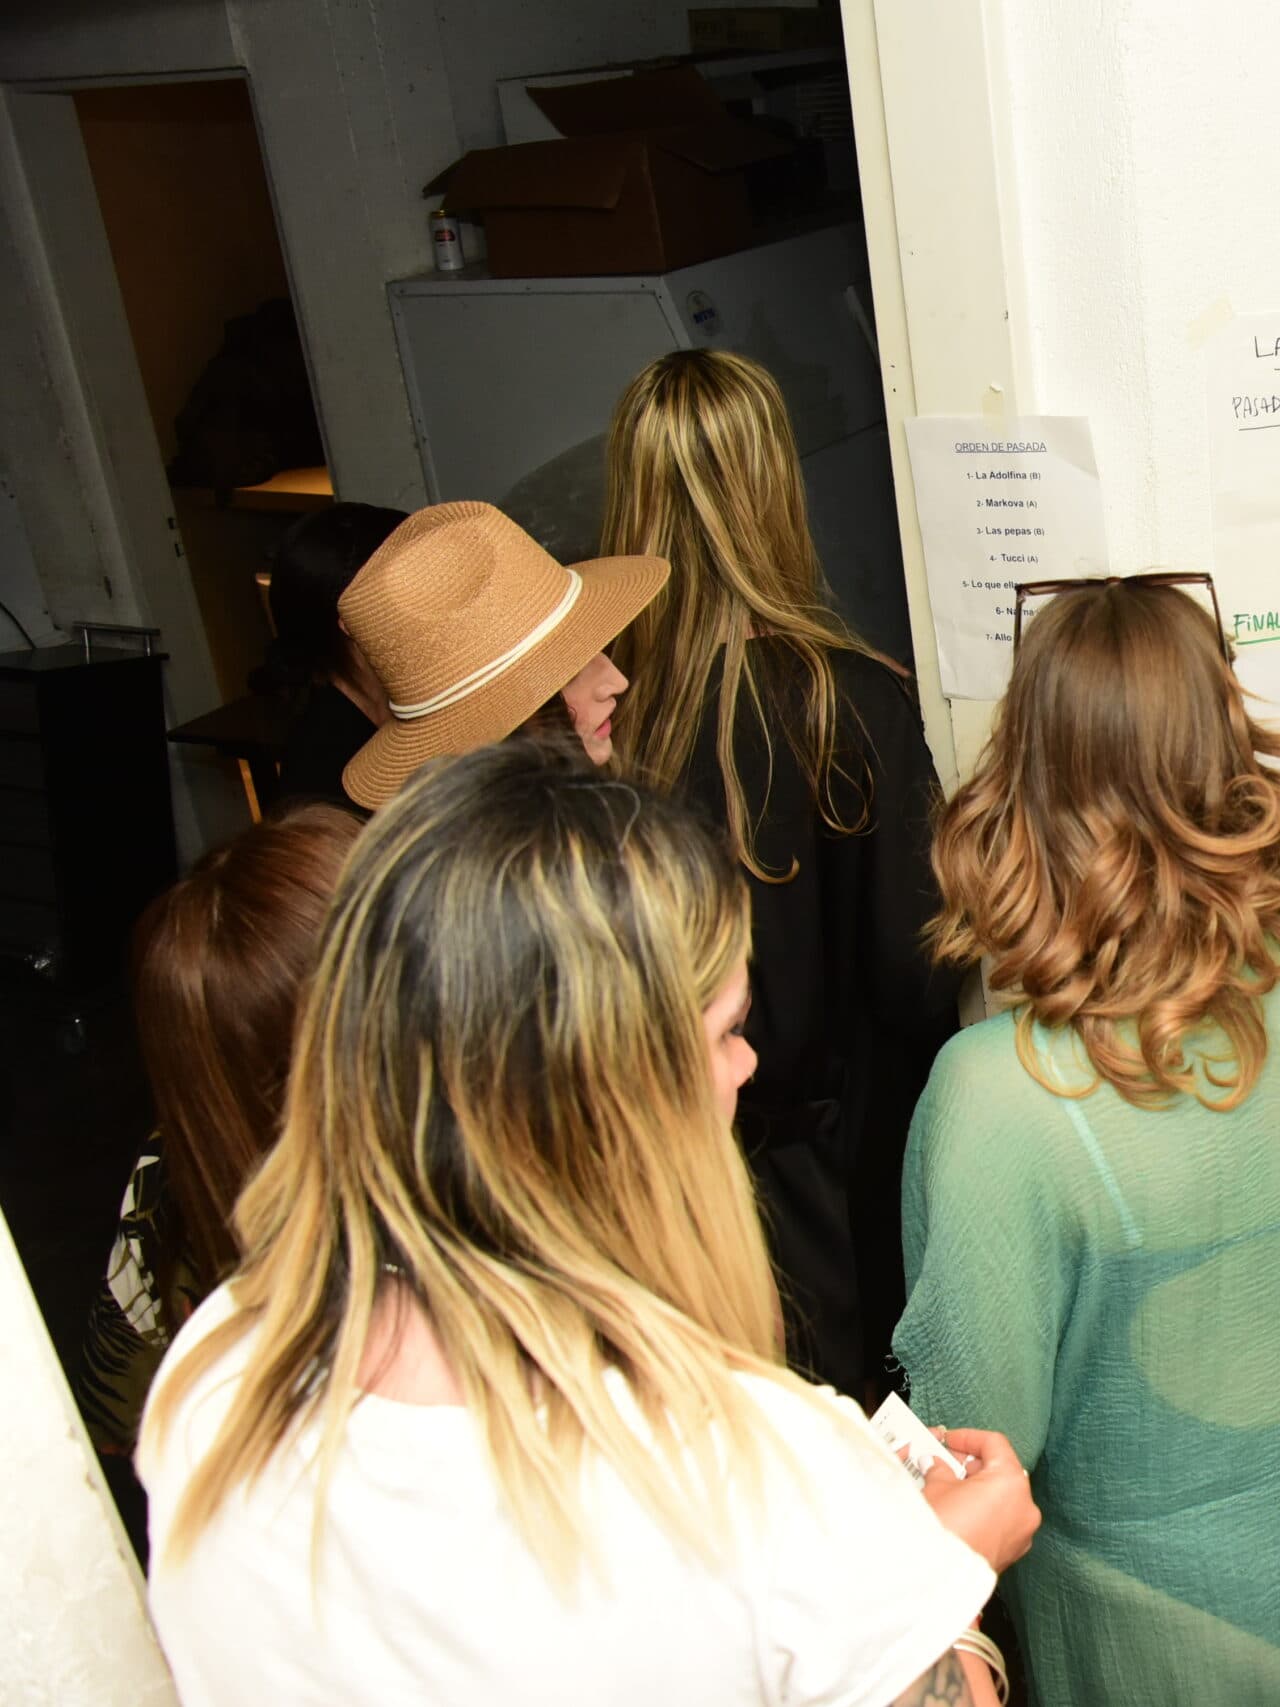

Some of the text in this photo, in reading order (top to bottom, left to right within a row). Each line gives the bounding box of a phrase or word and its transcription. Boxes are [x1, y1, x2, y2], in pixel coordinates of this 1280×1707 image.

[954, 442, 1047, 453] ORDEN DE PASADA
[975, 471, 987, 480] La
[989, 470, 1027, 480] Adolfina
[1029, 472, 1041, 481] (B)
[985, 498, 1024, 508] Markova
[1026, 500, 1038, 508] (A)
[985, 526, 1002, 535] Las
[1004, 527, 1031, 537] pepas
[1033, 527, 1045, 536] (B)
[1000, 553, 1025, 562] Tucci
[1027, 555, 1039, 563] (A)
[971, 580, 983, 588] Lo
[984, 582, 1001, 591] que
[994, 633, 1012, 642] Allo
